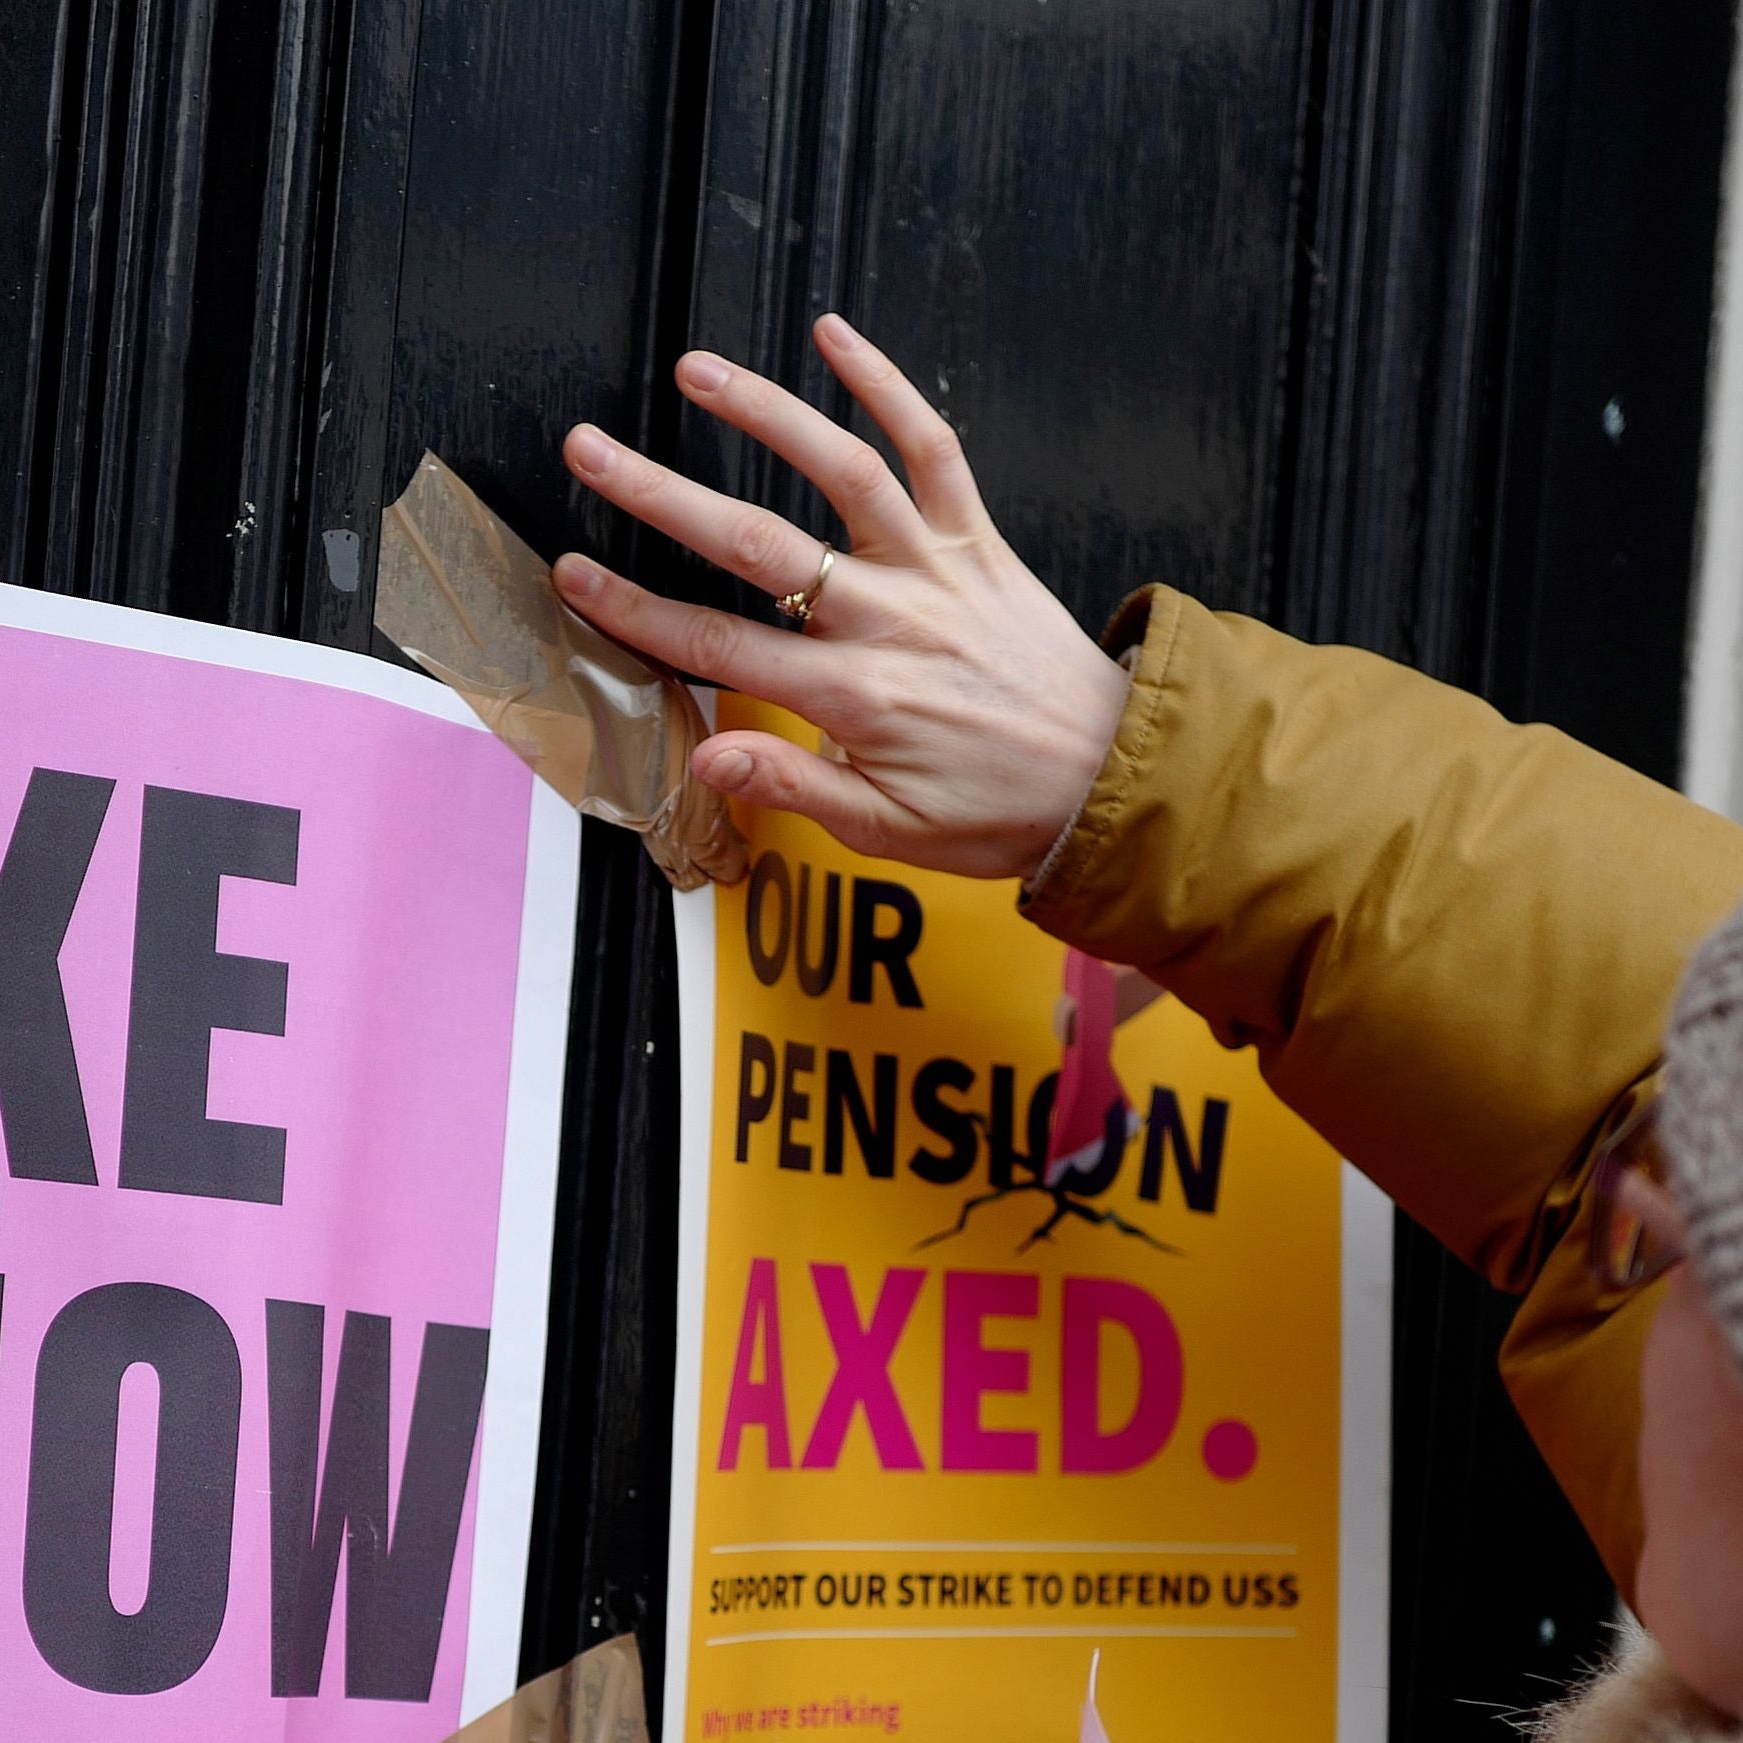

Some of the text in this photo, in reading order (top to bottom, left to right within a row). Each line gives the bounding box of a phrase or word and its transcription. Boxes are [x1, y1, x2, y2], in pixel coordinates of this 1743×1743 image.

[744, 848, 926, 1010] OUR
[716, 1256, 1260, 1483] AXED.
[709, 1572, 1301, 1614] SUPPORT OUR STRIKE TO DEFEND USS
[759, 1707, 791, 1730] are
[797, 1697, 901, 1735] striking
